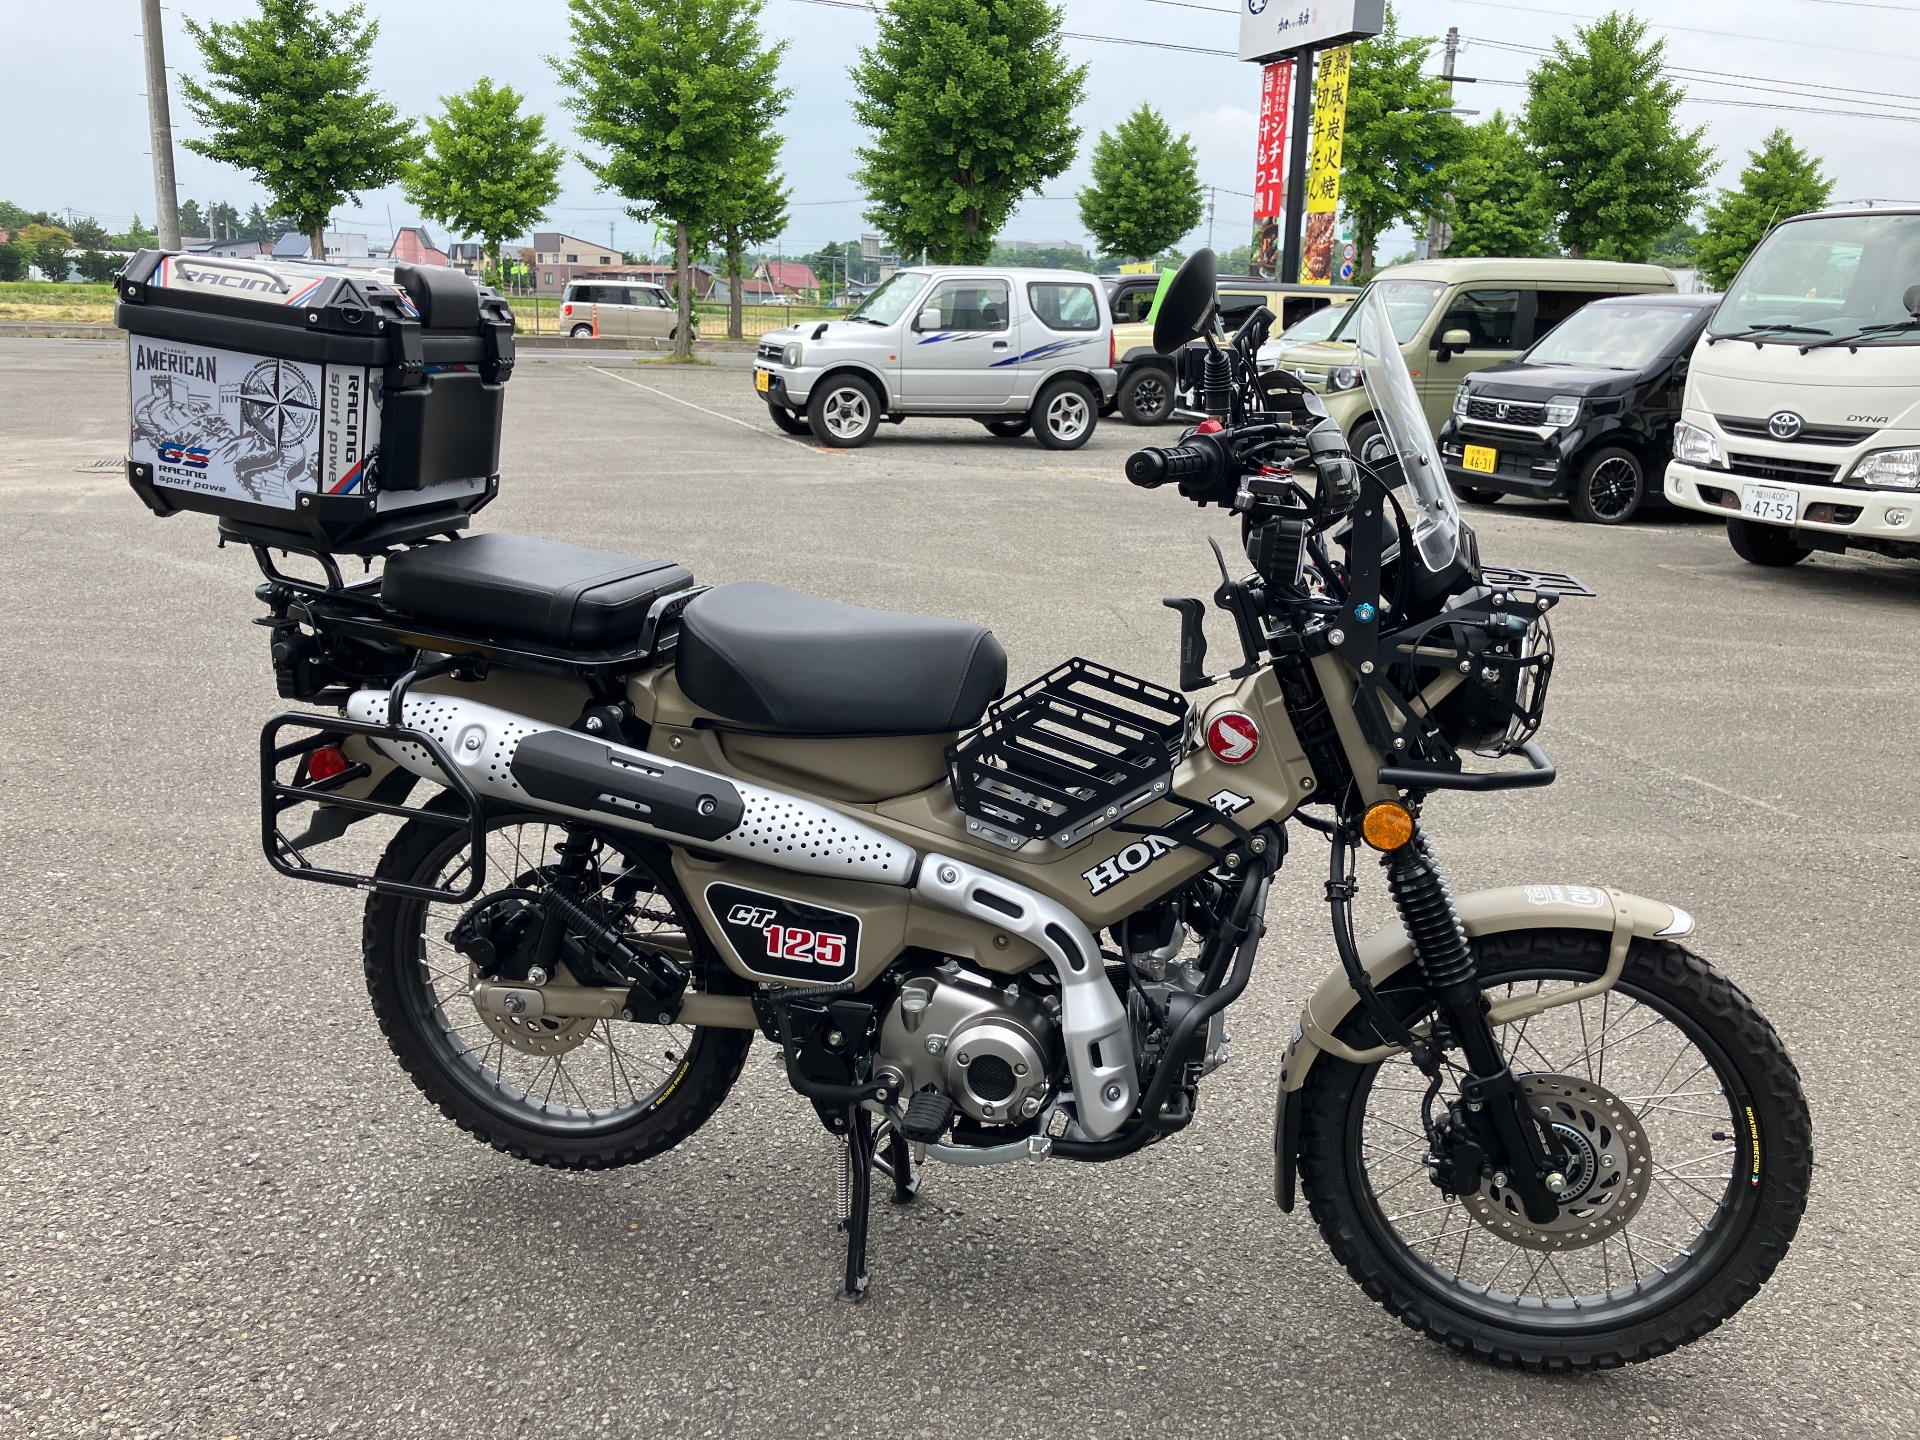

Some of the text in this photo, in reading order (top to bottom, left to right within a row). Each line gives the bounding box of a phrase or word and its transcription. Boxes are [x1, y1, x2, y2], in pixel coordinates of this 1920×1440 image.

[1309, 55, 1333, 200] 厚切牛たん
[1268, 116, 1284, 212] シチュー
[136, 344, 217, 384] AMERICAN
[327, 372, 340, 482] sport powe
[345, 375, 360, 463] RACING
[1846, 414, 1889, 423] DYNA
[158, 442, 211, 469] GS
[158, 465, 208, 480] RACING
[1470, 456, 1491, 470] 46-31
[158, 475, 227, 493] sport powe
[1753, 501, 1793, 521] 47-52
[1082, 789, 1255, 895] HONA
[727, 904, 777, 928] CT
[763, 924, 847, 967] 125
[1745, 1106, 1760, 1174] ROTATING DIRECTION
